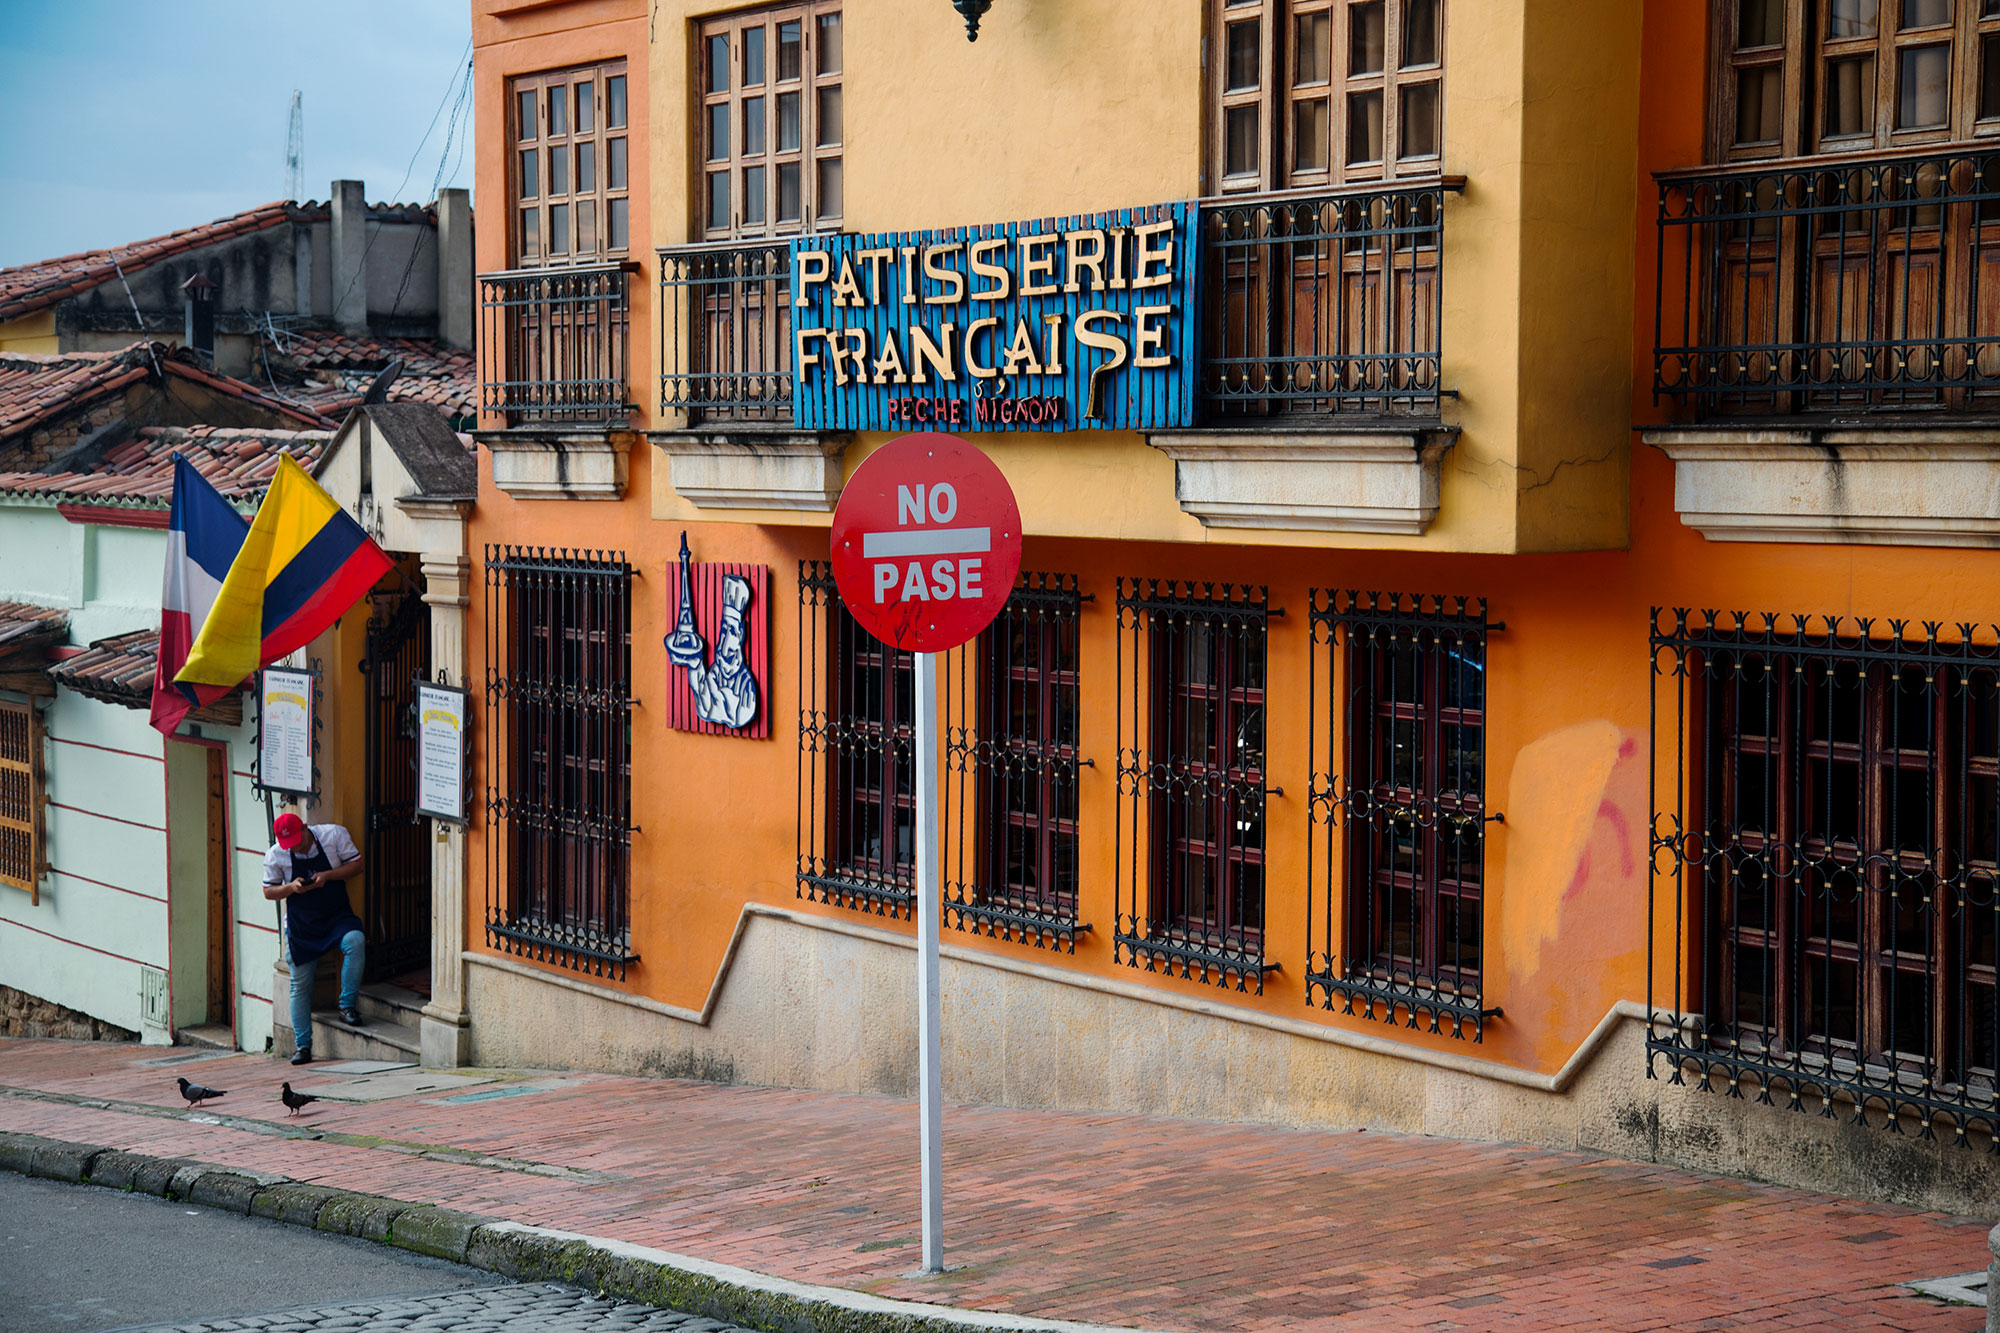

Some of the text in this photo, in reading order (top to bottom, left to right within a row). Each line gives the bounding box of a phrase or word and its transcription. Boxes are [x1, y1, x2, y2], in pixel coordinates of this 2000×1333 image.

[796, 220, 1173, 306] PATISSERIE
[888, 395, 1059, 424] PECHE MIGNON
[897, 482, 958, 525] NO
[873, 558, 983, 604] PASE
